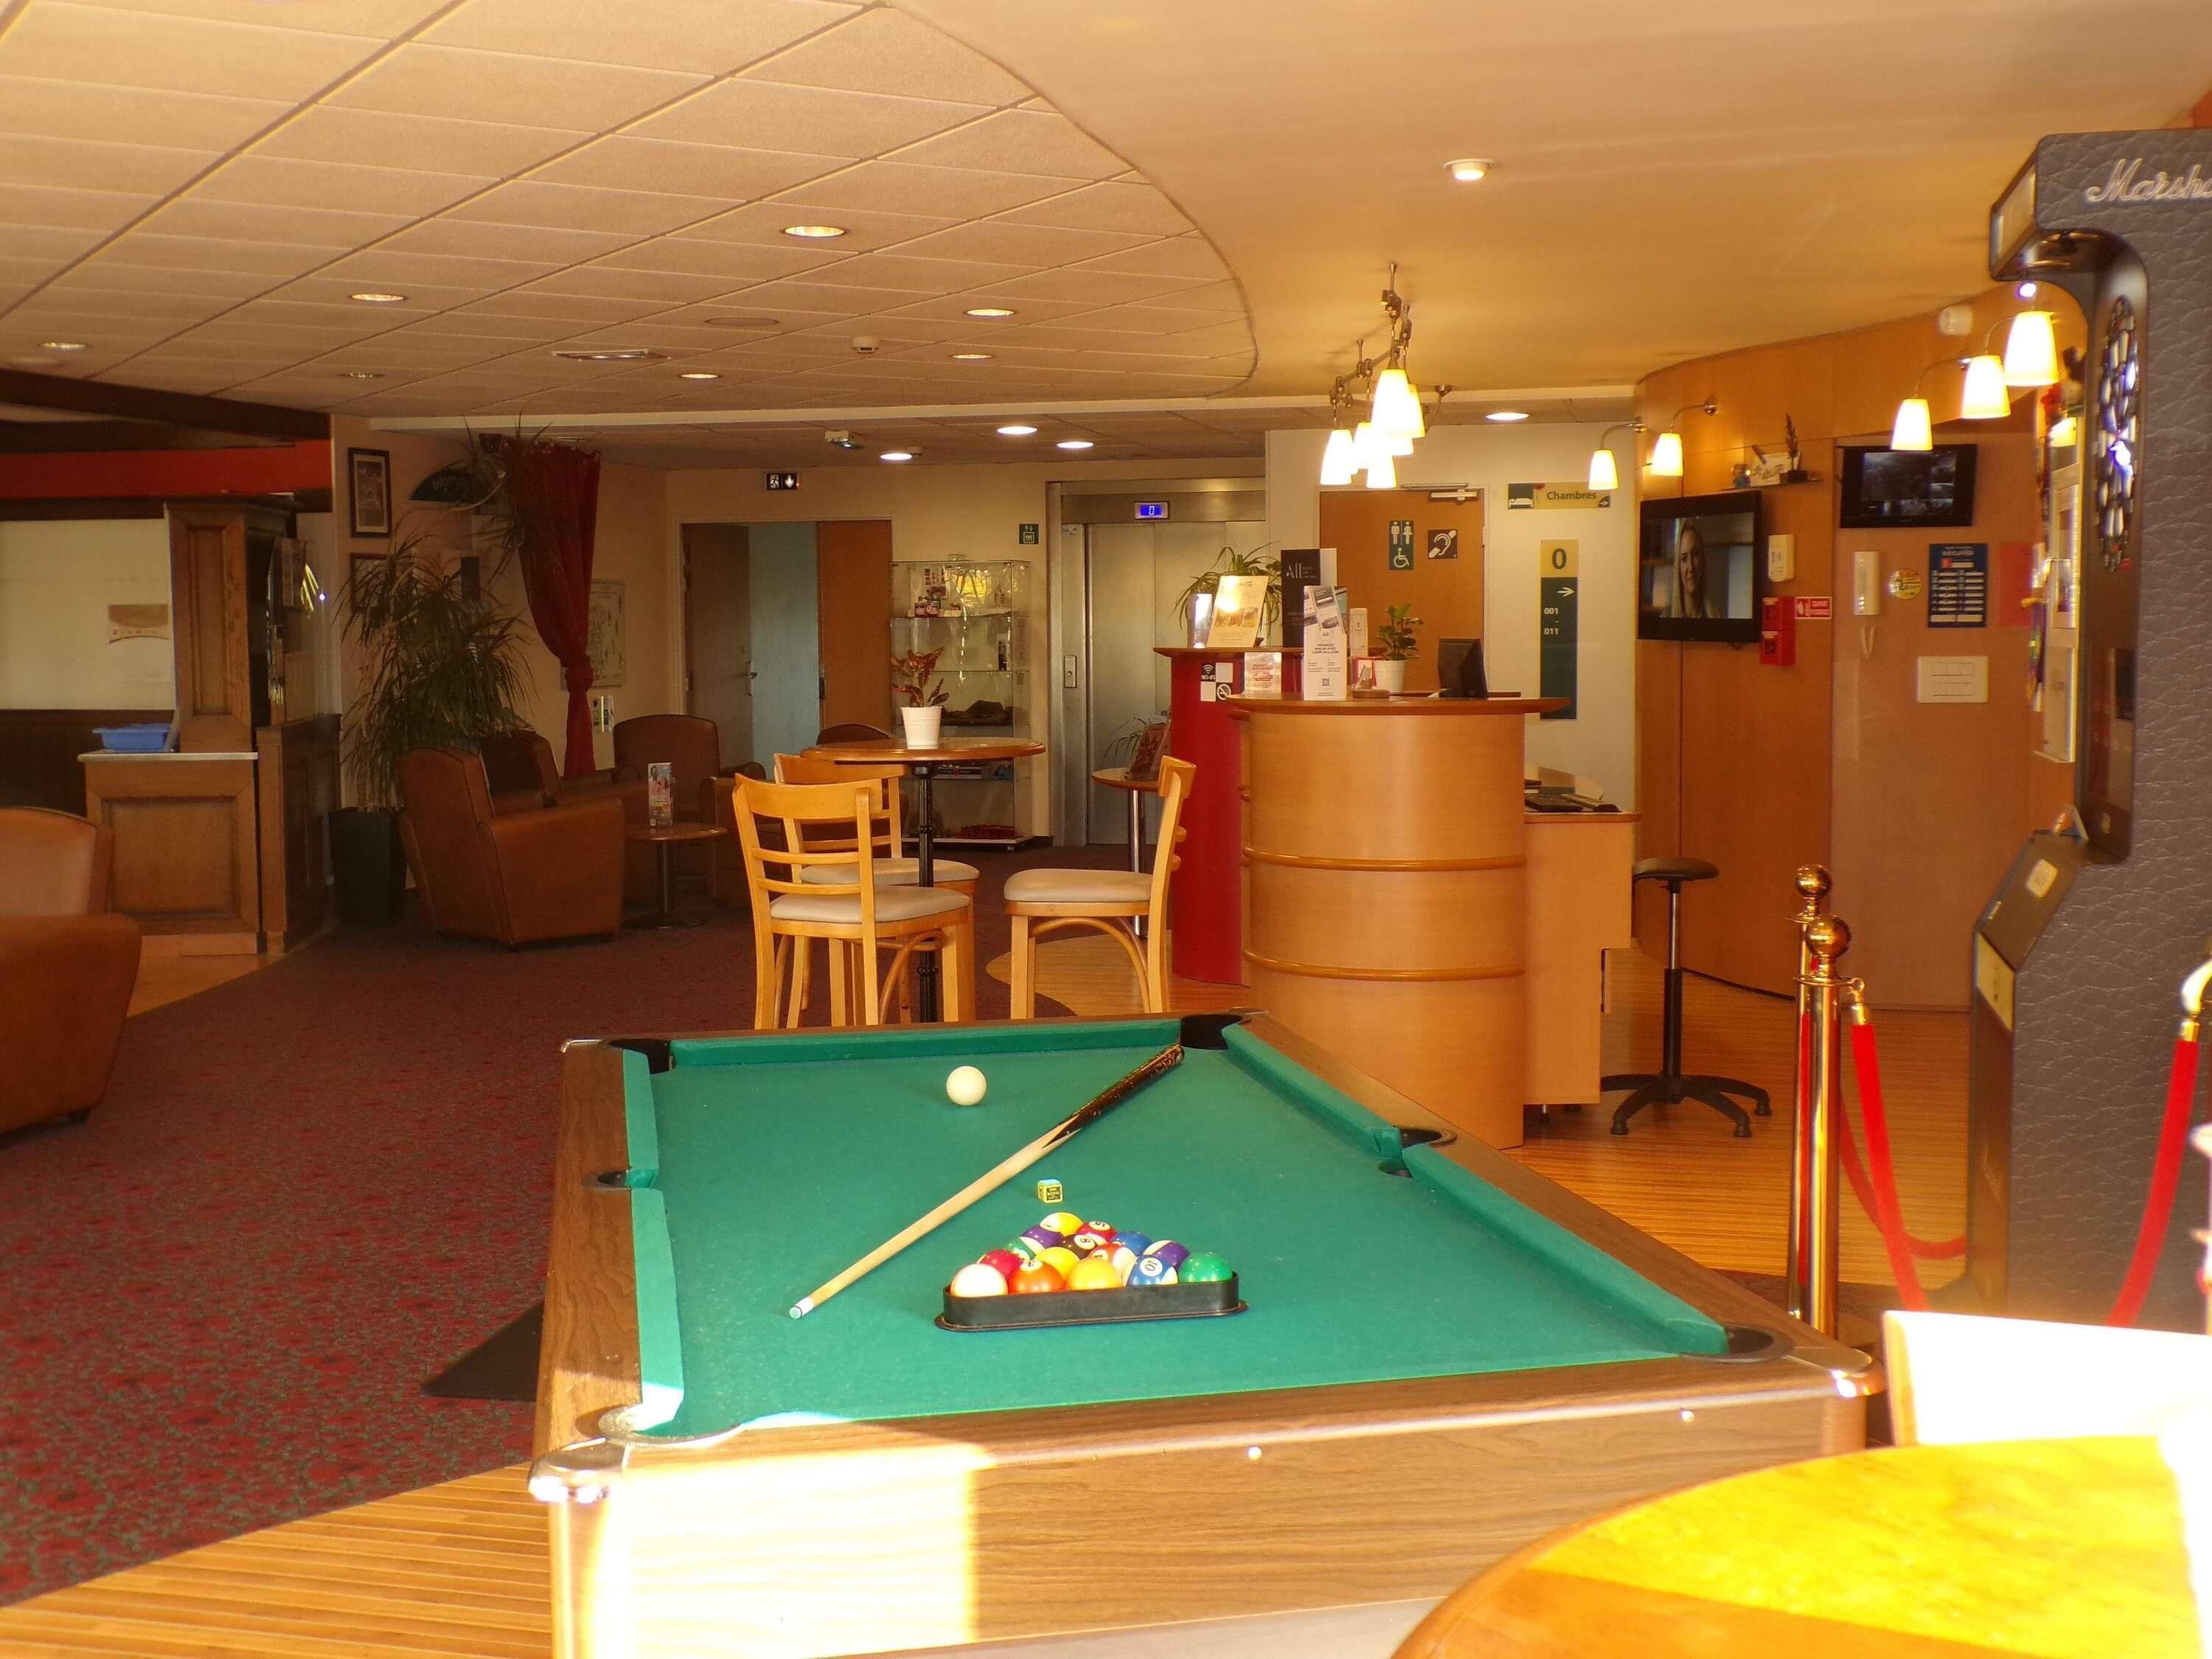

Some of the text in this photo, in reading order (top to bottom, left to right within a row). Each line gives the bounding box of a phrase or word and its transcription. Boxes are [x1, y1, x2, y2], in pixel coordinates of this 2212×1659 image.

[1547, 490, 1597, 501] Chambres
[1149, 506, 1155, 515] 0
[1552, 548, 1567, 570] 0
[1544, 607, 1559, 615] 001
[1145, 1260, 1158, 1271] 10
